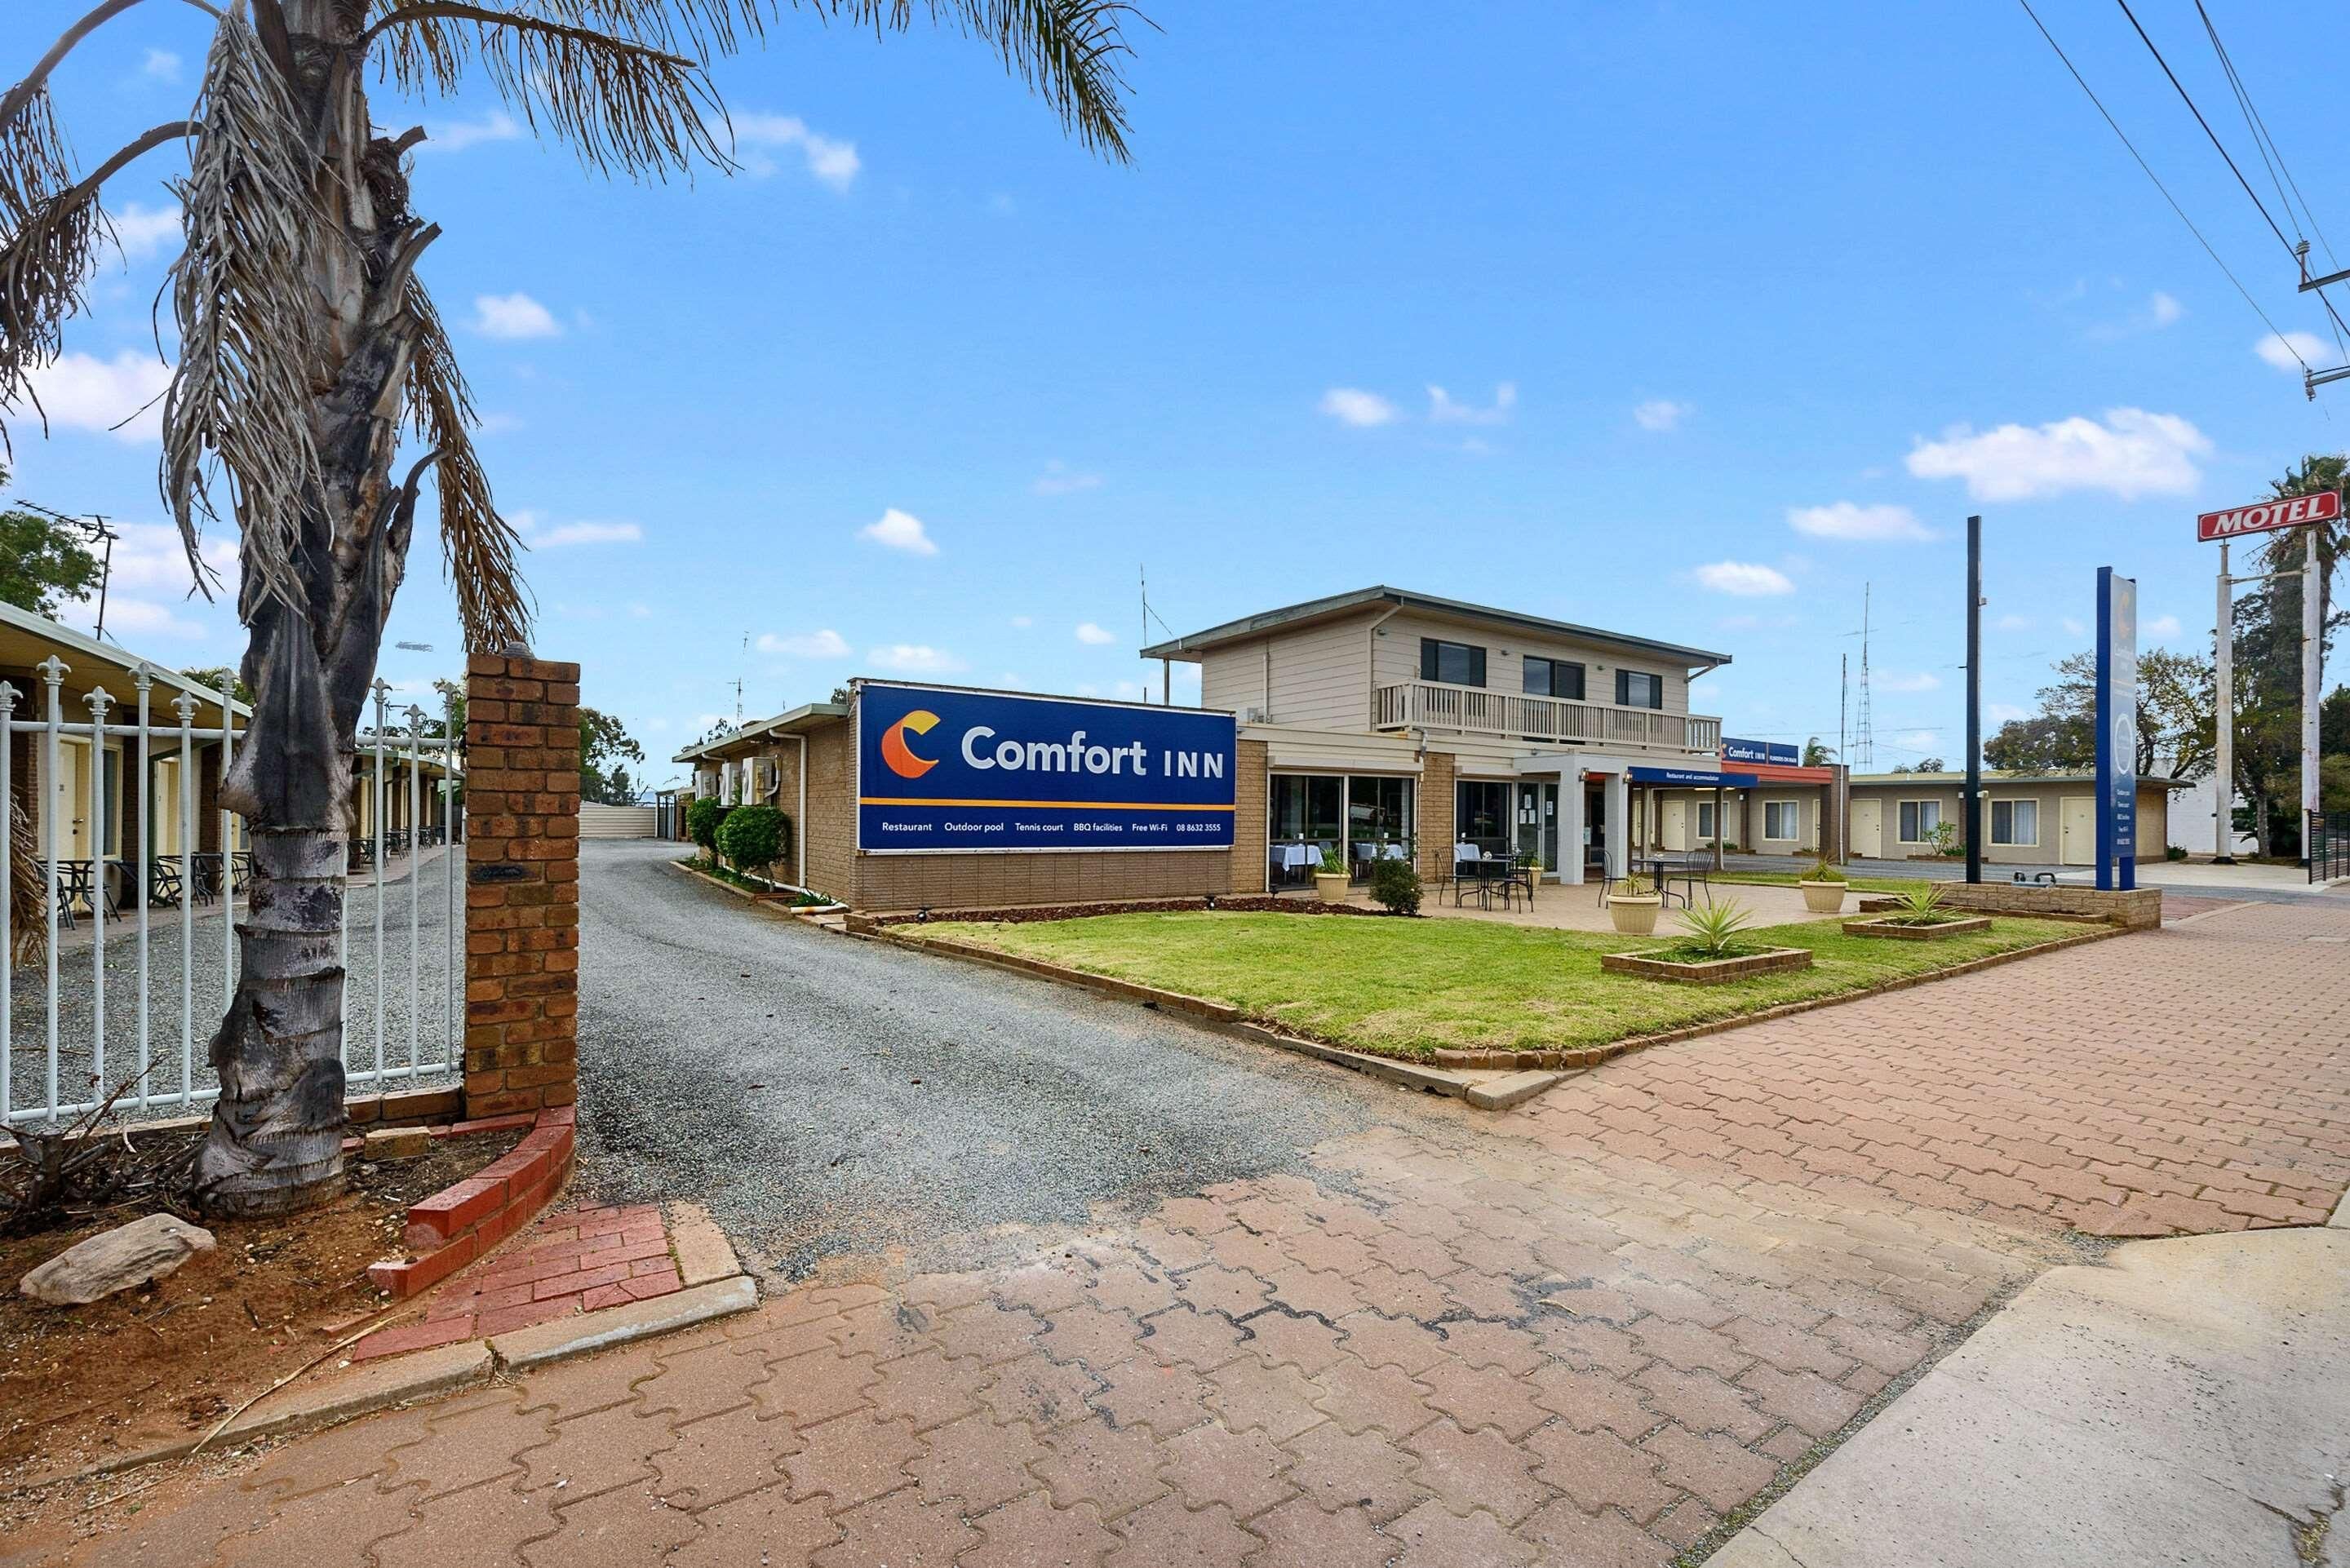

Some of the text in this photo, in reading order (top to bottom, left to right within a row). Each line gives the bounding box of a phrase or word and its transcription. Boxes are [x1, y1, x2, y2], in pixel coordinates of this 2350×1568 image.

[2212, 497, 2325, 535] MOTEL
[961, 725, 1223, 778] Comfort INN
[1728, 746, 1754, 759] Comfort
[882, 822, 1221, 833] Restaurant Outdoor pool Tennis court BBQ facilities Free Wi-Fi 08 8632 3555
